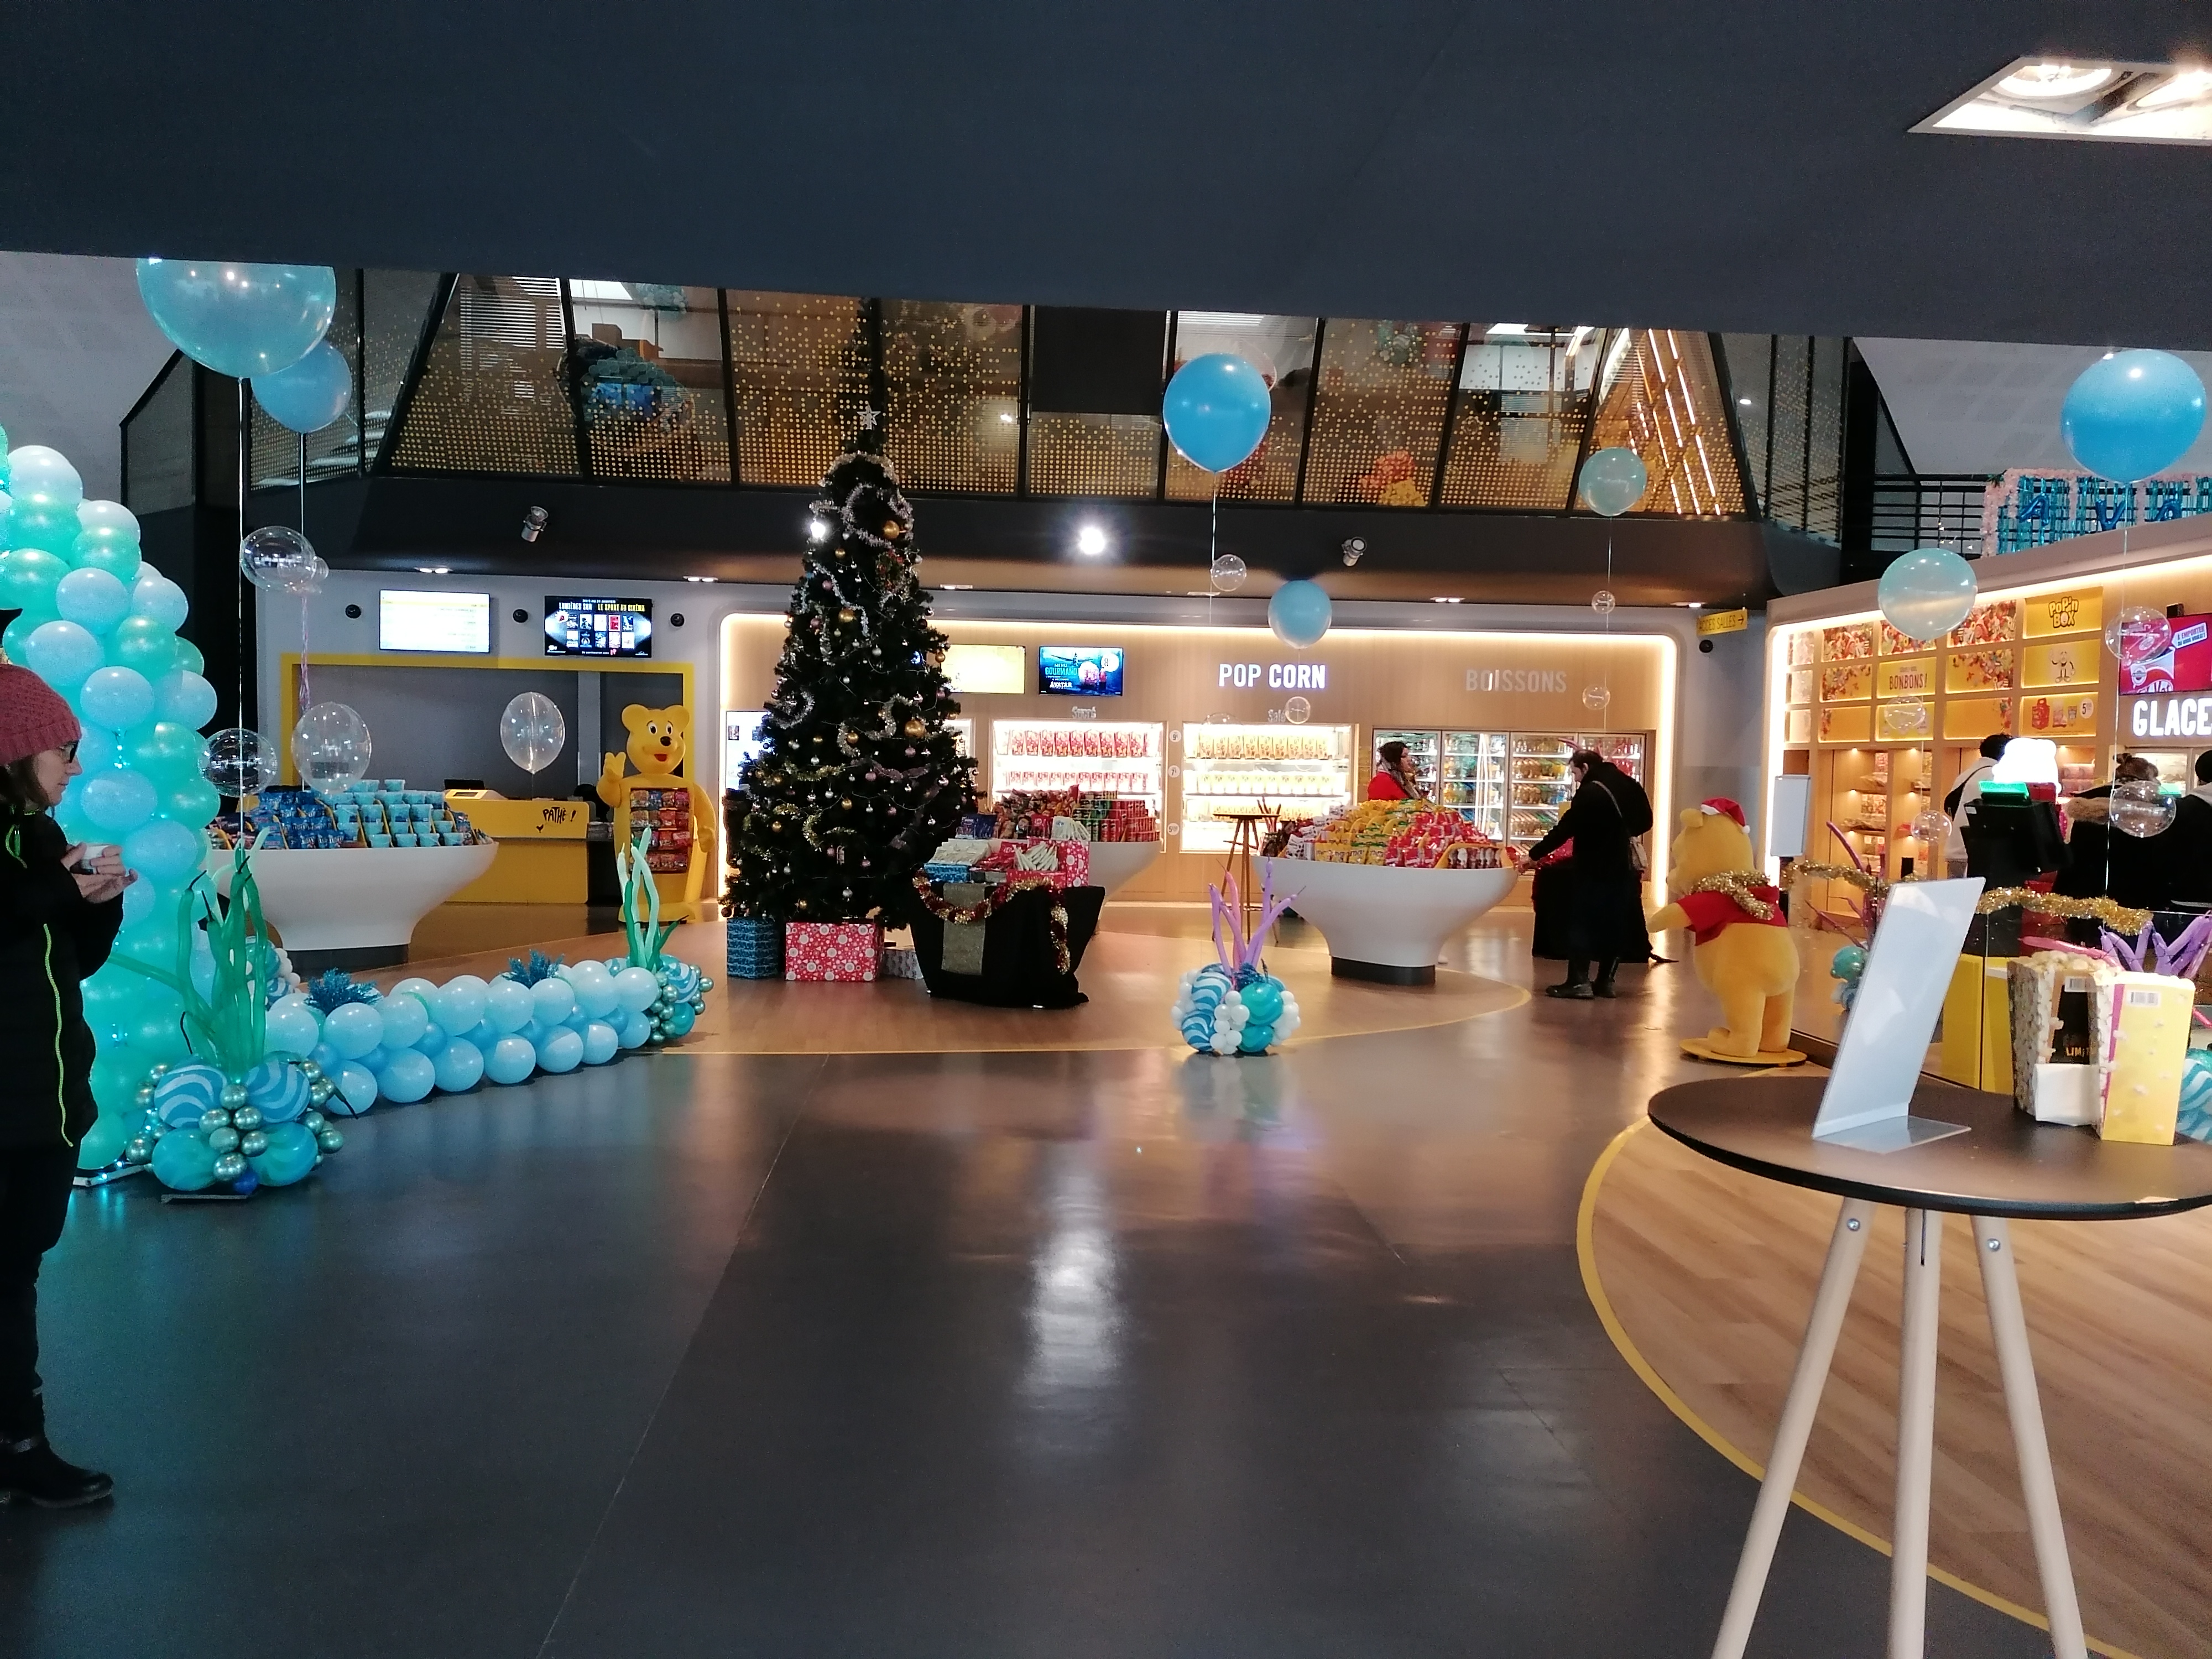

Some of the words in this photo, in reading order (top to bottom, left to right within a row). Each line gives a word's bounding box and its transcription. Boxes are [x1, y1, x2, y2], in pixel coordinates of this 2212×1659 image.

[604, 603, 619, 612] SPORT
[2053, 611, 2075, 628] BOX
[1045, 667, 1077, 675] GOURMAND
[1218, 664, 1262, 687] POP
[1268, 664, 1326, 689] CORN
[1465, 669, 1567, 693] BOISSONS
[2132, 697, 2212, 737] GLACE
